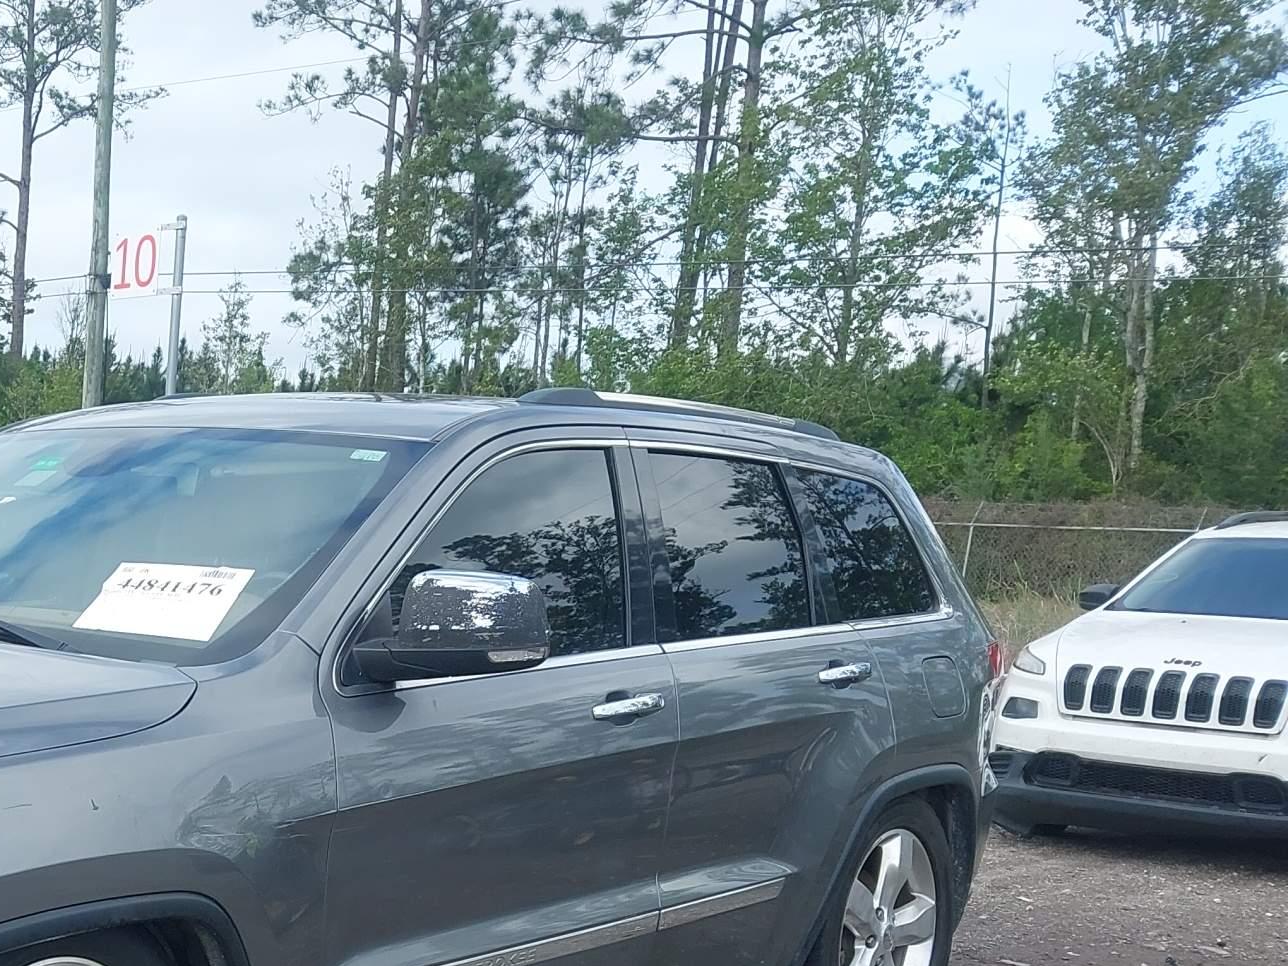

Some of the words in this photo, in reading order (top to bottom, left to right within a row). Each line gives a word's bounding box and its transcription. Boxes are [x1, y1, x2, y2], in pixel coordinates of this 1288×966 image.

[113, 234, 157, 289] 10
[116, 577, 226, 597] 44841476
[1163, 656, 1204, 668] Jeep
